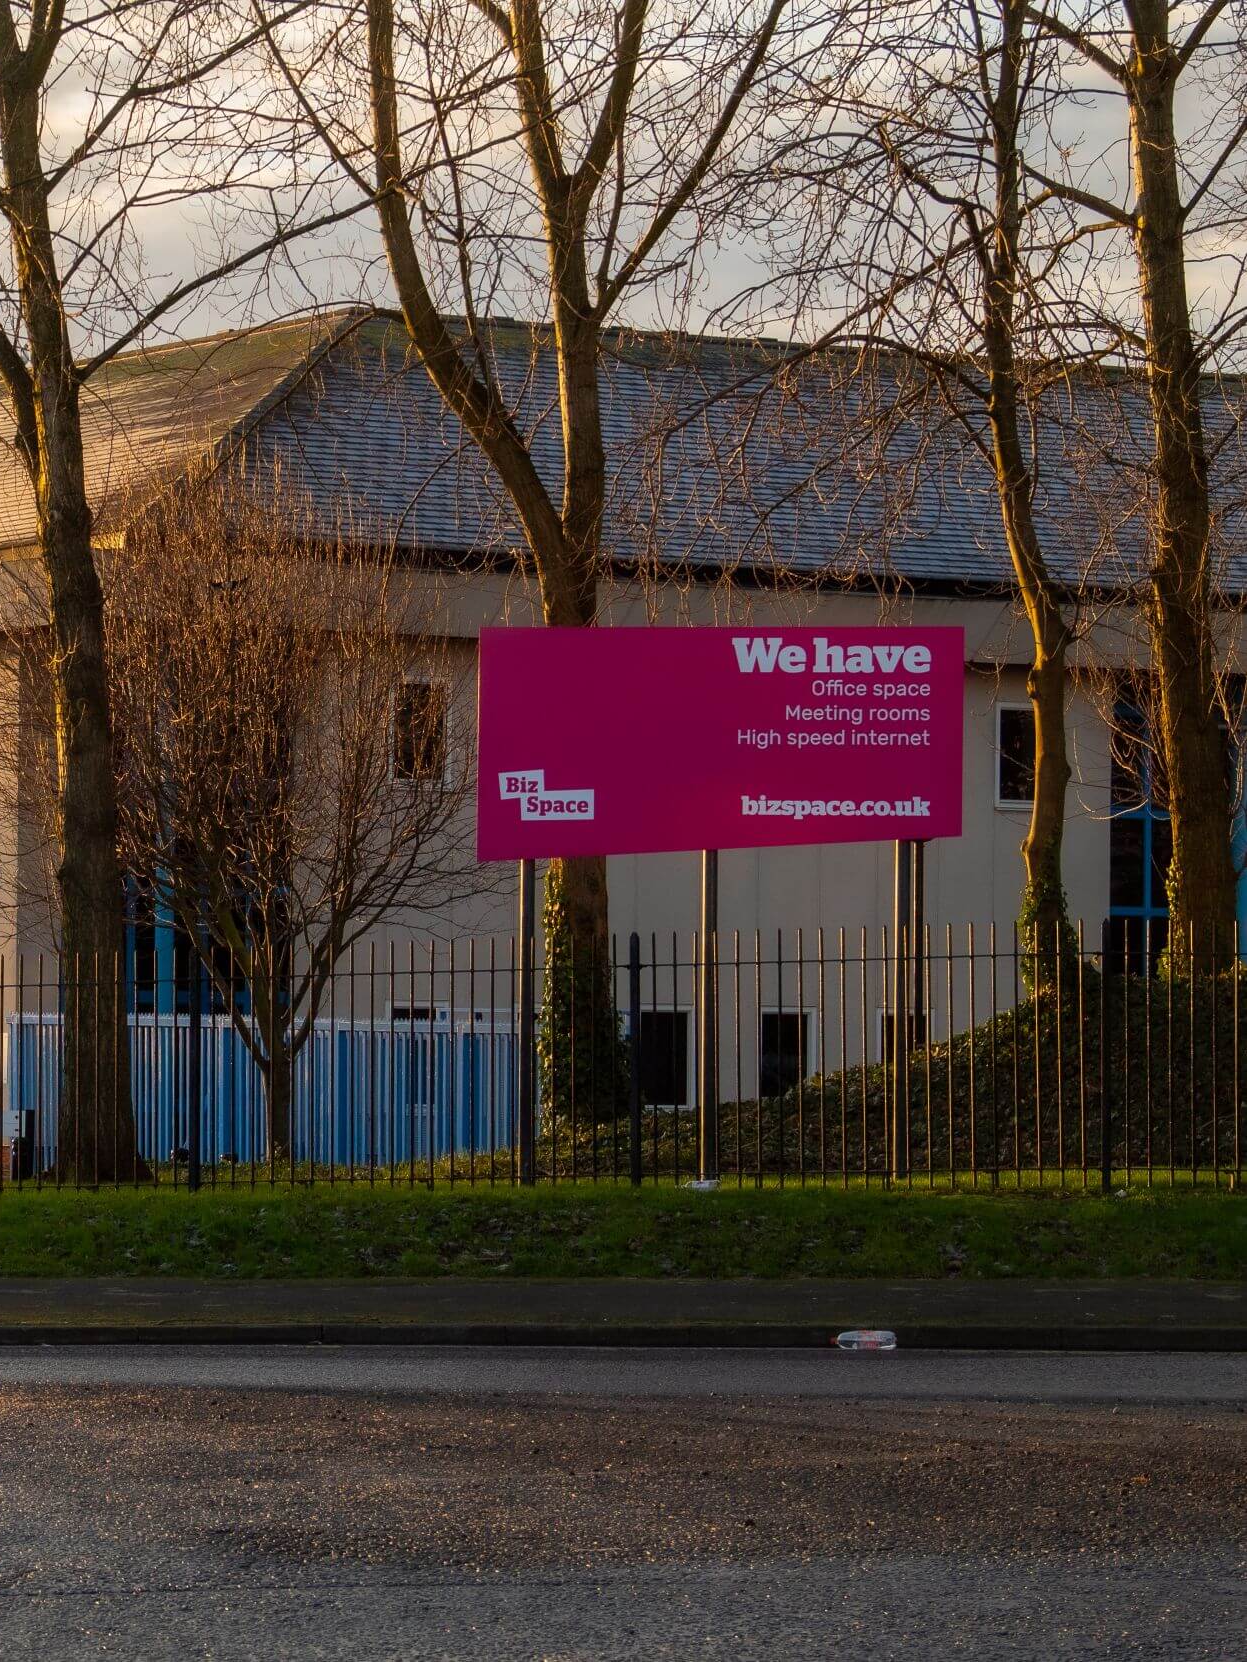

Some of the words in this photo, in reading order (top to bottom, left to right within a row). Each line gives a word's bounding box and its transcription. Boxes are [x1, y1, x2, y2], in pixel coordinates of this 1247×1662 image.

[731, 637, 807, 673] We
[812, 637, 932, 673] have
[811, 679, 867, 696] Office
[872, 683, 931, 700] space
[785, 704, 863, 725] Meeting
[868, 708, 931, 721] rooms
[737, 729, 782, 749] High
[786, 729, 845, 749] speed
[851, 729, 931, 746] internet
[505, 776, 539, 793] Biz
[526, 795, 589, 816] Space
[740, 795, 931, 820] bizspace.co.uk
